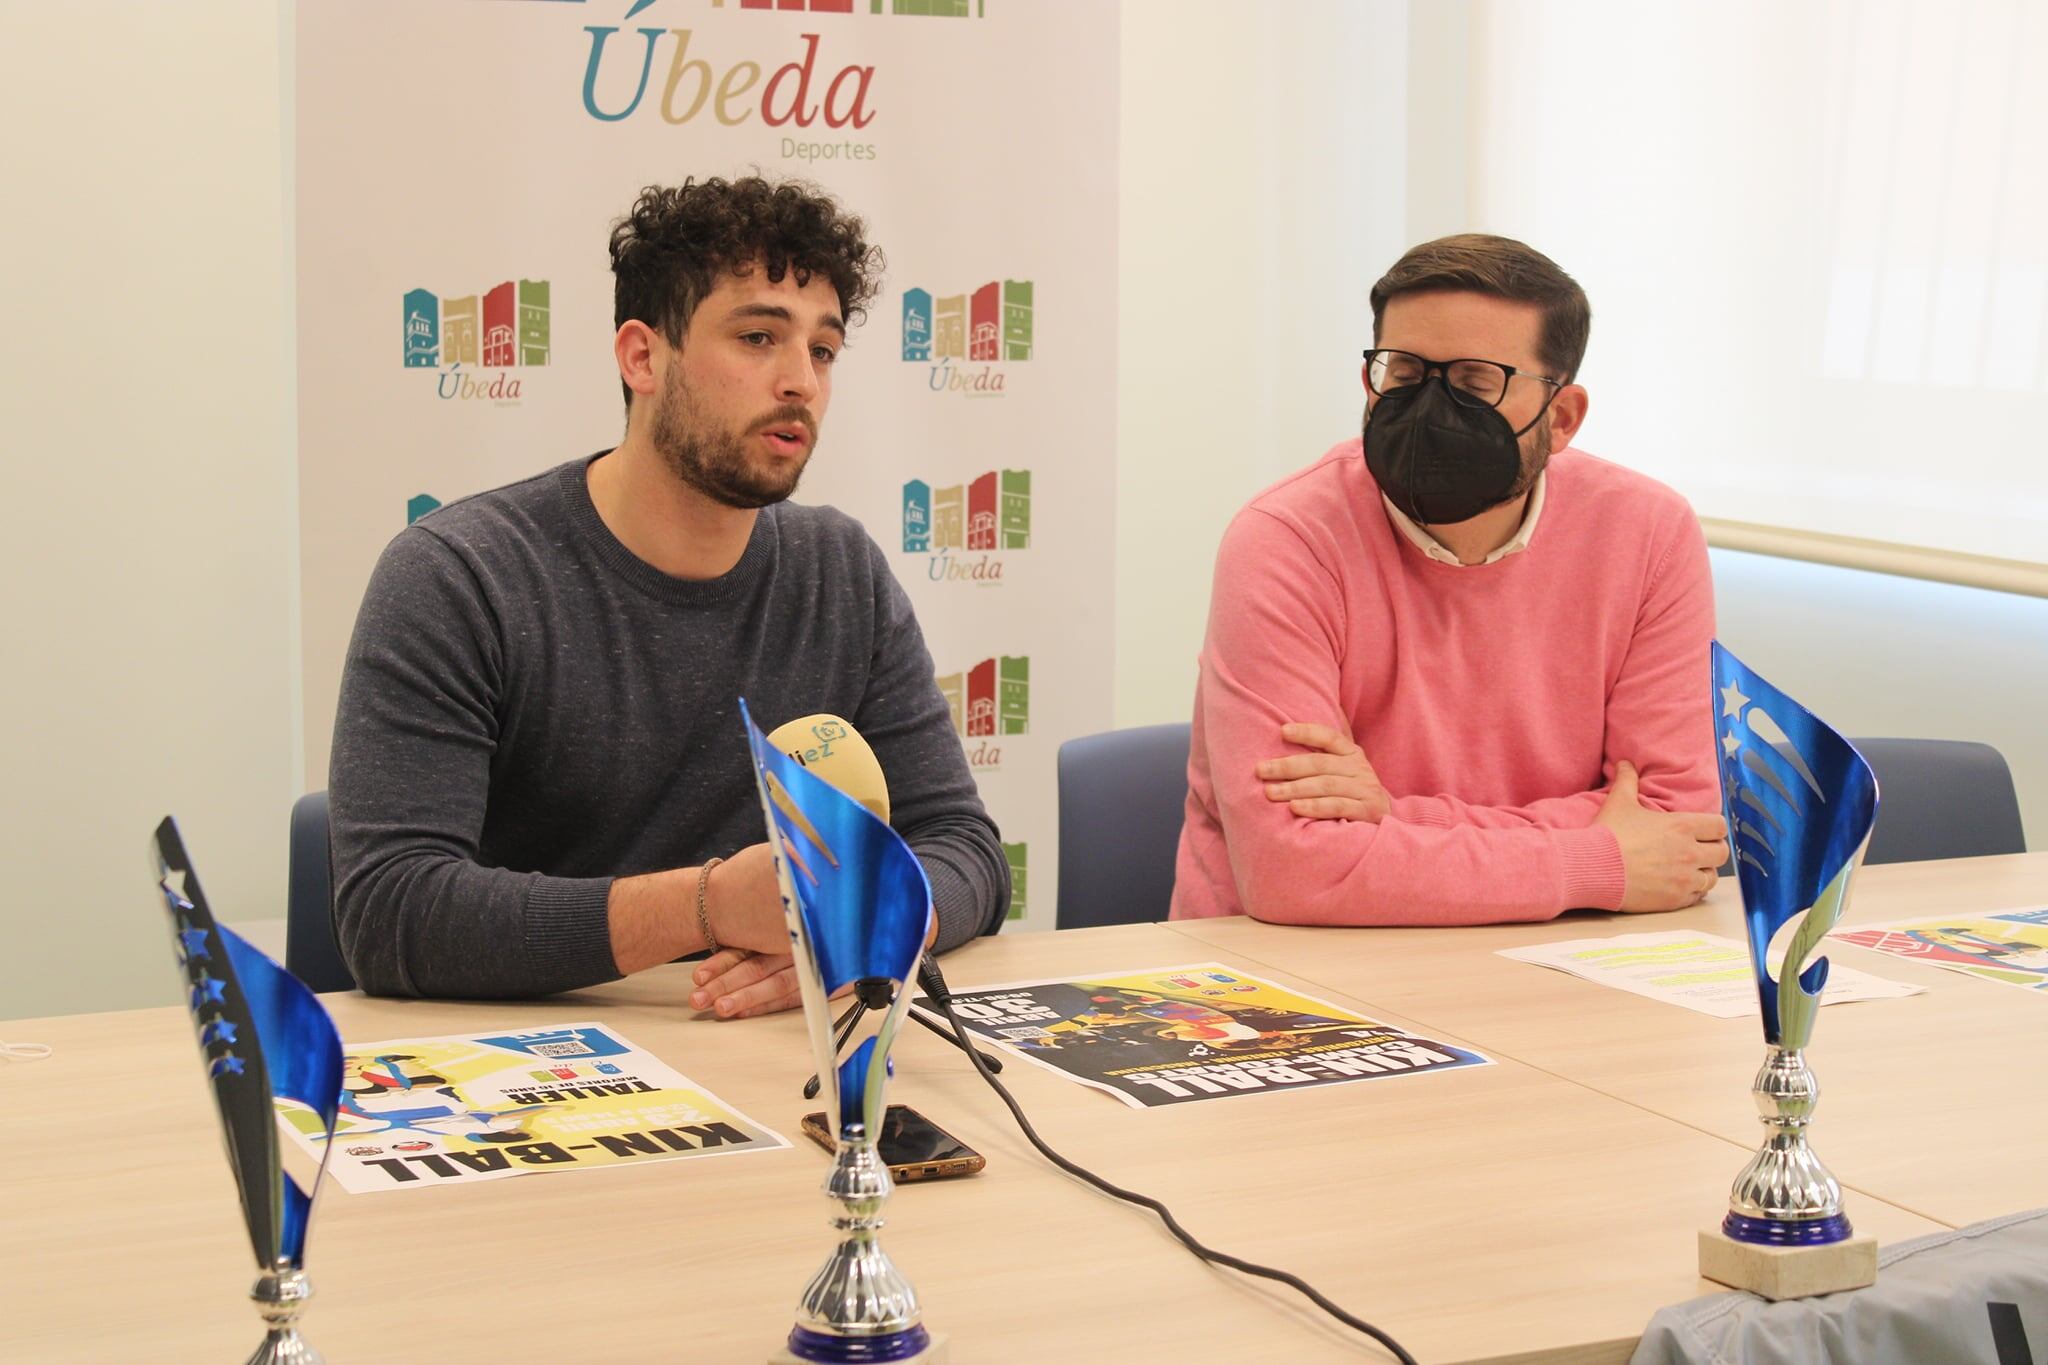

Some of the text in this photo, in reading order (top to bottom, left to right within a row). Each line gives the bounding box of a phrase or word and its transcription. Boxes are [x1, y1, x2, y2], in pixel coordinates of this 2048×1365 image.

[582, 0, 877, 129] Úbeda
[781, 137, 877, 163] Deportes
[438, 362, 521, 399] Úbeda
[929, 357, 1005, 391] Úbeda
[929, 547, 1003, 581] Úbeda
[788, 743, 834, 766] iez
[950, 999, 1052, 1019] 30
[973, 1011, 1062, 1026] ABRIL
[1122, 1041, 1416, 1081] CAMPEONATO
[1132, 1045, 1456, 1098] KIN-BALL
[506, 1080, 662, 1105] TALLER
[645, 1109, 711, 1126] 23
[361, 1122, 753, 1182] KIN-BALL
